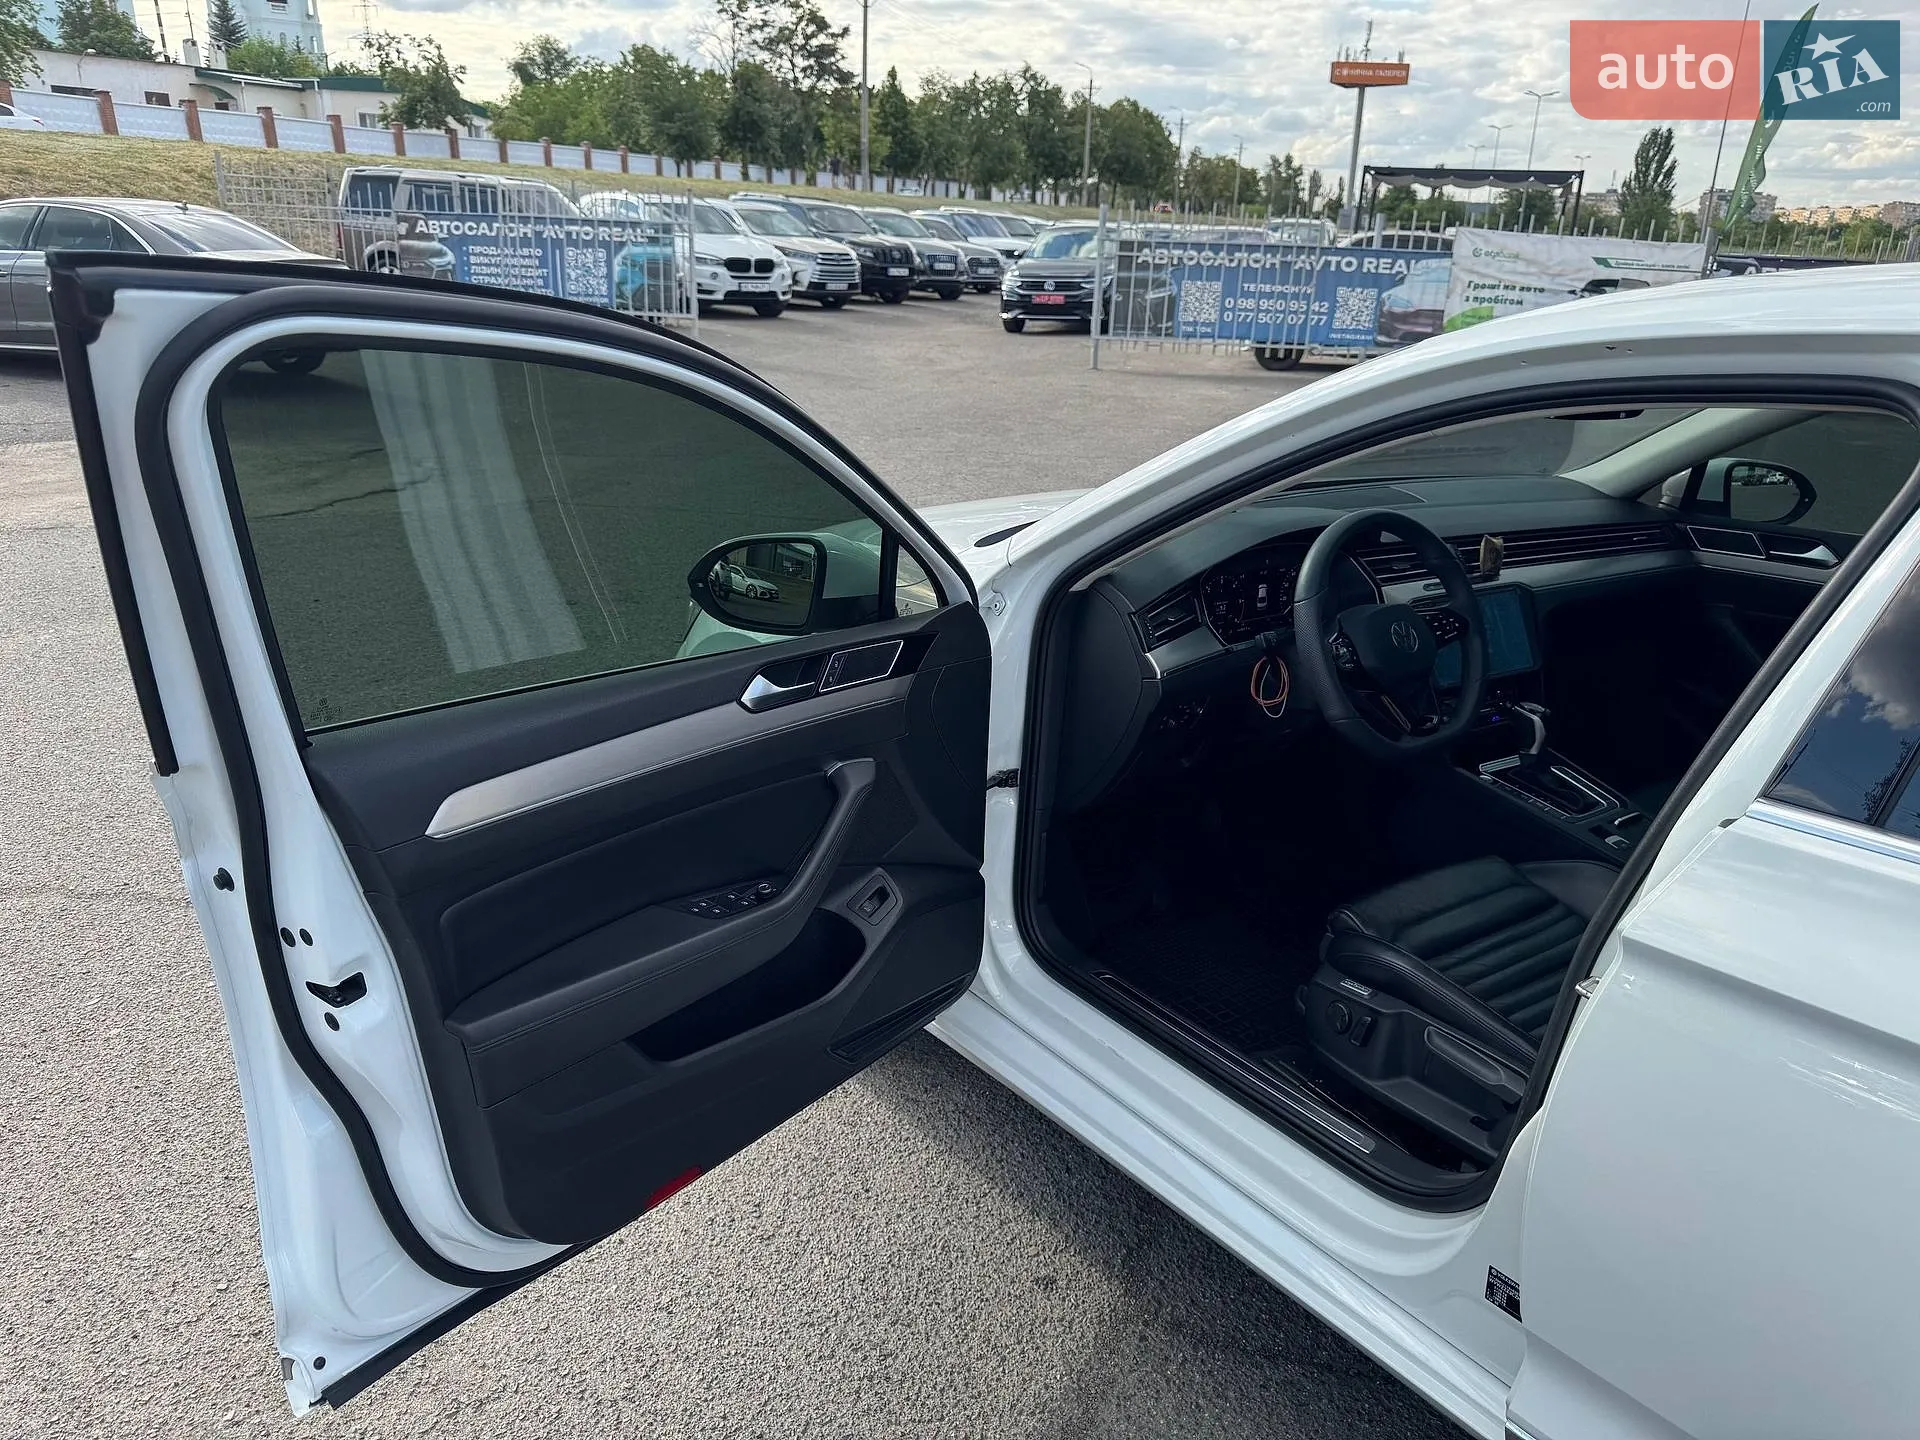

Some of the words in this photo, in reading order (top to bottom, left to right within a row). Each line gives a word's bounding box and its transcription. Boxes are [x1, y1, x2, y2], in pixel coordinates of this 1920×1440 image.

[415, 219, 532, 238] АВТОСАЛОН
[1137, 247, 1280, 268] АВТОСАЛОН
[1472, 294, 1524, 306] пробігом
